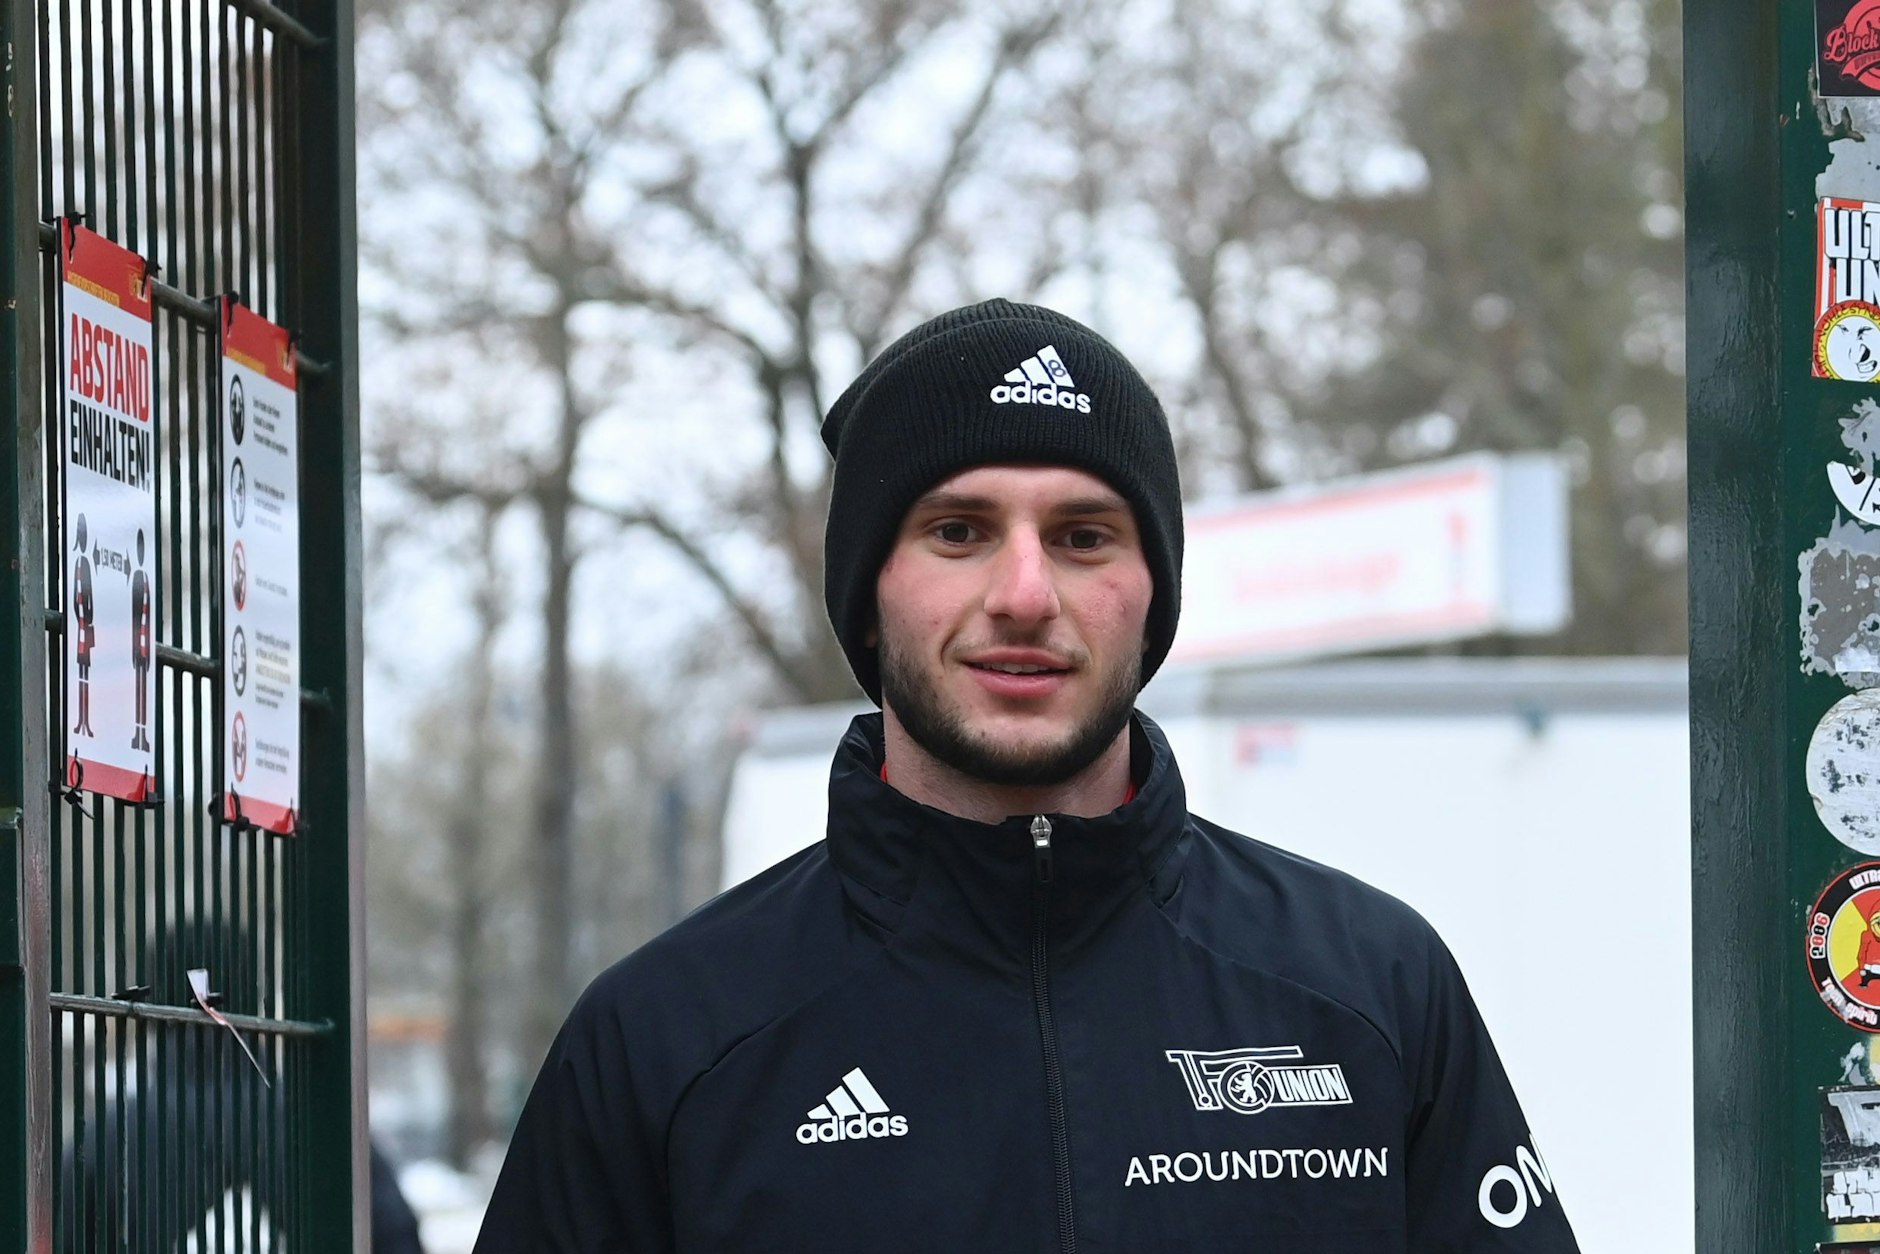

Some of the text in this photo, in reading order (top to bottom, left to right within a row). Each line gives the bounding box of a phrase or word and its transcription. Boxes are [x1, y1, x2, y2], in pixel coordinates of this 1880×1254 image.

[70, 312, 149, 422] ABSTAND
[990, 380, 1091, 414] adidas
[70, 398, 150, 494] EINHALTEN!
[1810, 912, 1830, 959] 2006
[1271, 1067, 1348, 1102] UNION
[796, 1111, 909, 1144] adidas
[1125, 1147, 1388, 1187] AROUNDTOWN
